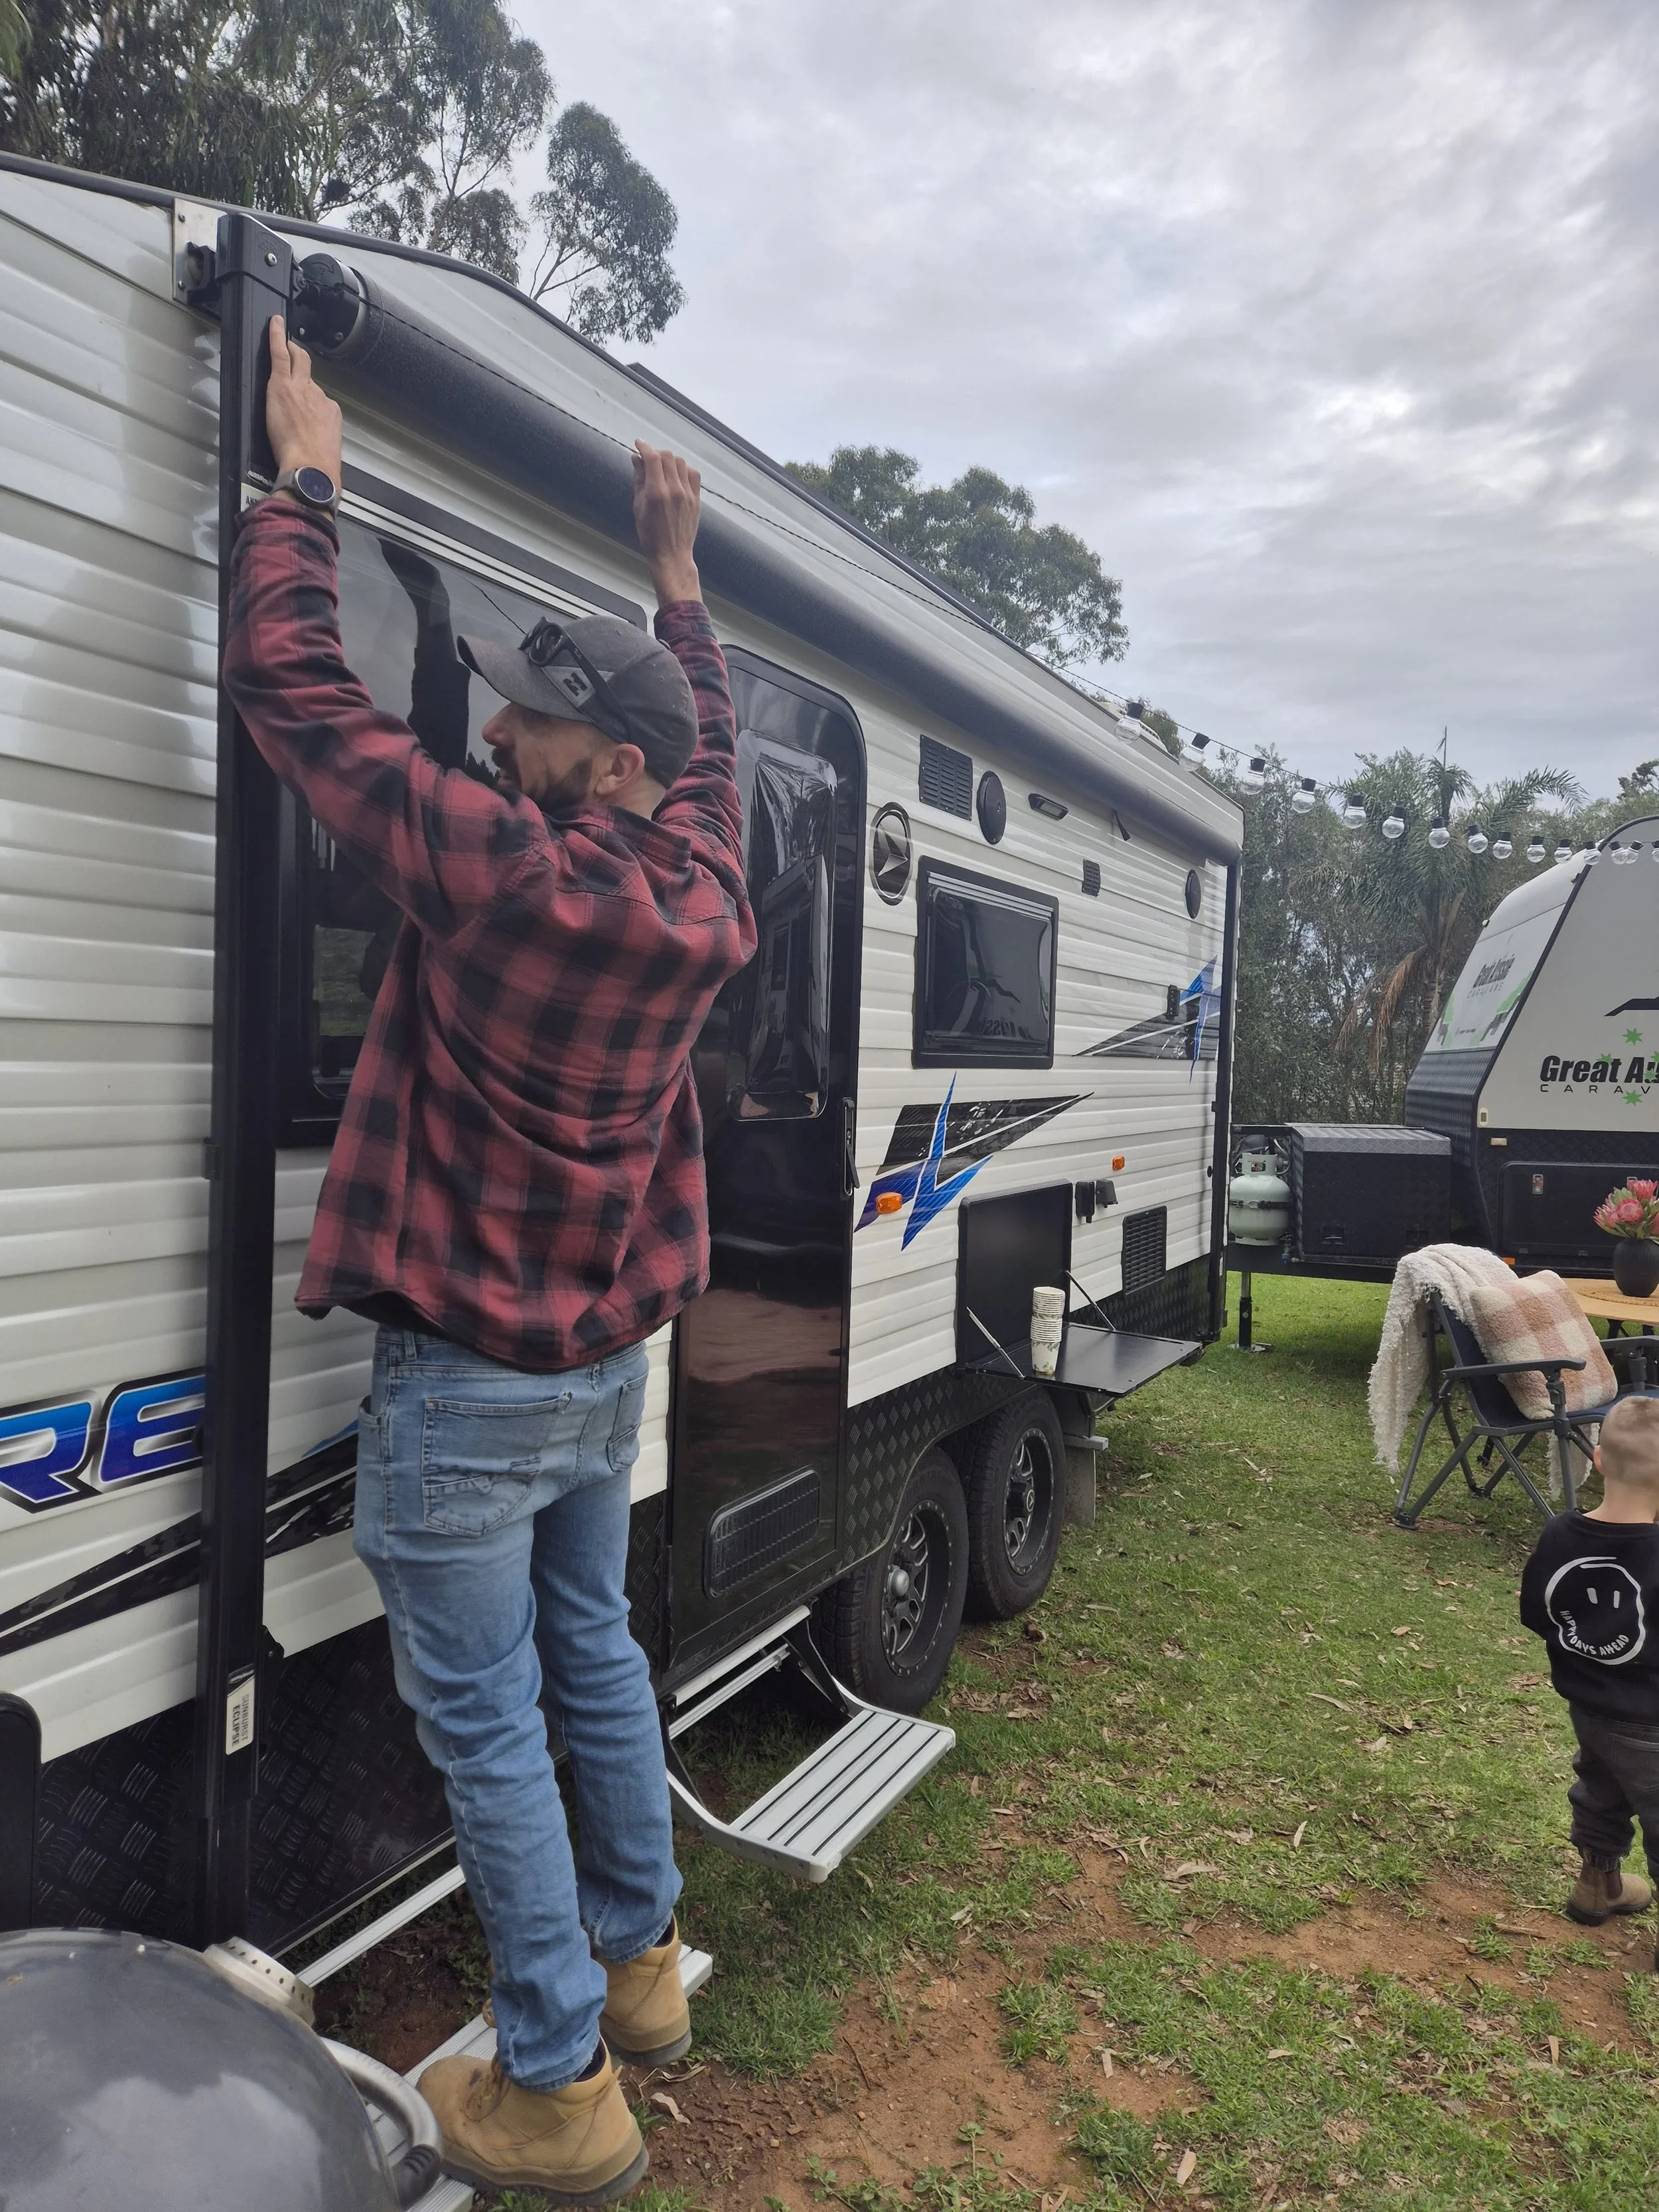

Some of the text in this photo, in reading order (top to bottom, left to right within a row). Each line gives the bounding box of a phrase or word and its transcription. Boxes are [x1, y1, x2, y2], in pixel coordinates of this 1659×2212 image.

[1540, 1055, 1623, 1082] Great
[1540, 1084, 1651, 1094] CARAV
[1559, 1610, 1629, 1656] HAPPY DAYS AHEAD
[232, 1704, 240, 1747] ECLIPSE
